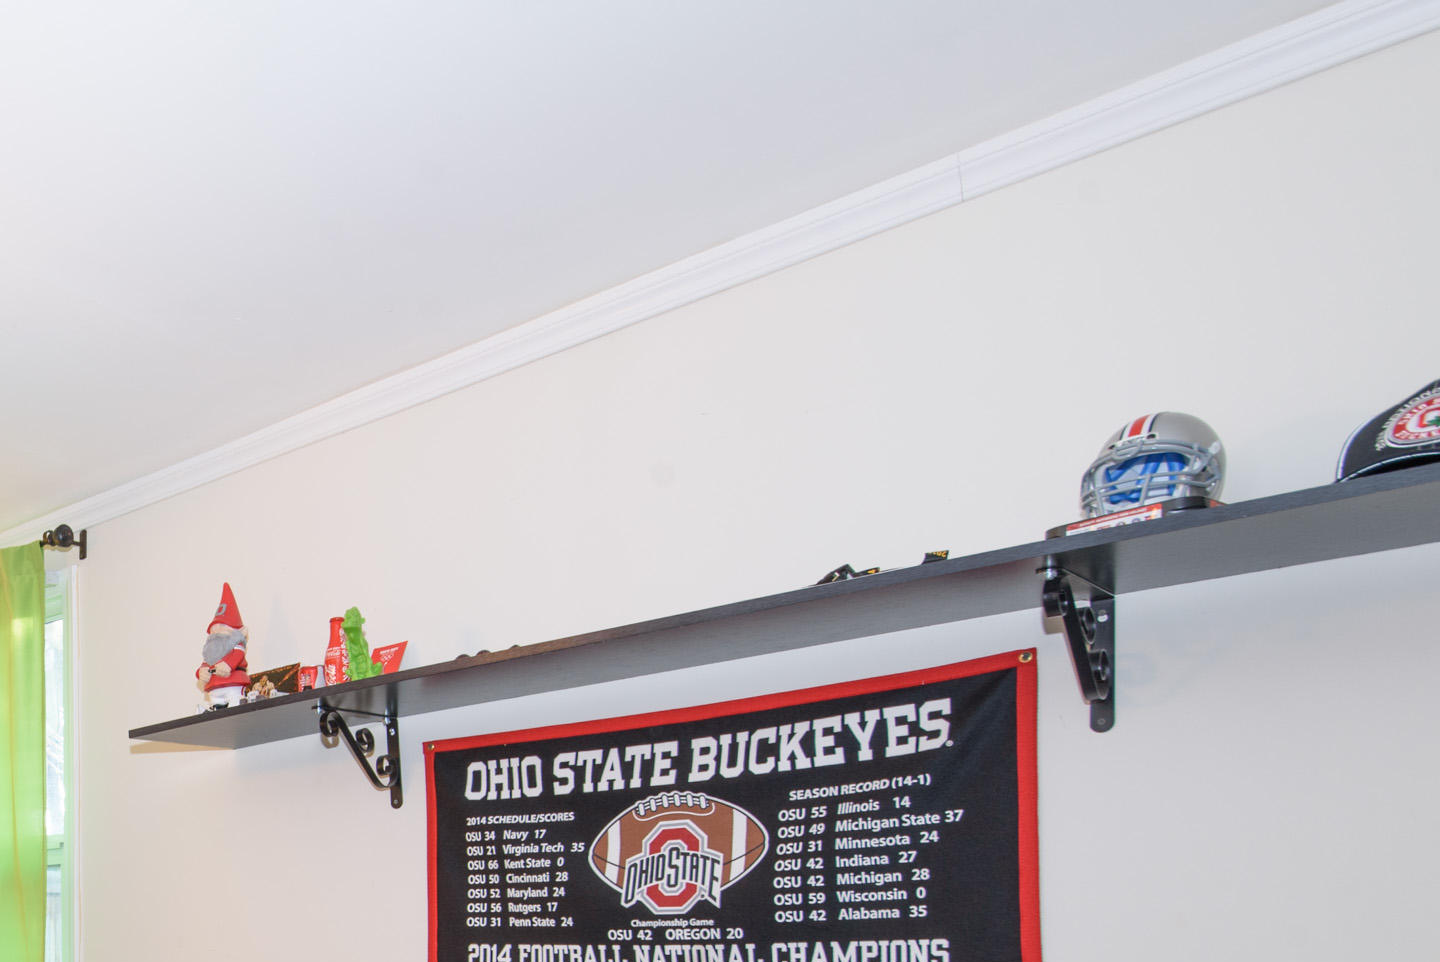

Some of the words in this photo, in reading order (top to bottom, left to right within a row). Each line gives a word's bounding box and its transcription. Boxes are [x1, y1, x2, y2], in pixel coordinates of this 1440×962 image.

[464, 756, 543, 800] OHIO
[552, 741, 679, 795] STATE
[789, 786, 839, 801] SEASON
[840, 779, 890, 795] RECORD
[891, 773, 932, 789] (14-1)
[778, 808, 806, 821] OSU
[811, 806, 827, 818] 55
[837, 800, 880, 814] Illinois
[893, 796, 911, 808] 14
[466, 817, 486, 826] 2014
[488, 812, 575, 824] SCHEDULE/SCORES
[778, 825, 804, 838] OSU
[809, 823, 825, 835] 49
[835, 818, 899, 832] Michigan
[901, 813, 940, 826] State
[945, 810, 964, 822] 37
[465, 832, 481, 842] OSU
[484, 831, 495, 841] 34
[503, 830, 529, 841] Navy
[534, 829, 546, 838] 17
[776, 843, 803, 855] OSU
[808, 840, 823, 852] 31
[835, 835, 910, 849] Minnesota
[920, 830, 939, 843] 24
[467, 846, 484, 856] OSU
[487, 846, 496, 855] 21
[503, 843, 539, 856] Virginia
[540, 842, 564, 853] Tech
[570, 843, 585, 852] 35
[467, 861, 485, 870] OSU
[488, 860, 499, 869] 66
[504, 860, 525, 869] Kent
[526, 858, 551, 868] State
[557, 857, 564, 867] 0
[774, 859, 801, 871] OSU
[806, 858, 824, 869] 42
[835, 855, 889, 867] Indiana
[899, 851, 917, 863] 27
[468, 875, 486, 884] OSU
[489, 875, 499, 884] 50
[506, 872, 550, 883] Cincinnati
[555, 872, 568, 882] 28
[773, 876, 801, 889] OSU
[807, 876, 824, 887] 42
[836, 871, 902, 885] Michigan
[911, 868, 930, 880] 28
[468, 889, 487, 898] OSU
[490, 889, 500, 898] 52
[507, 887, 548, 900] Maryland
[553, 887, 565, 897] 24
[774, 893, 802, 906] OSU
[808, 893, 826, 904] 59
[836, 888, 907, 903] Wisconsin
[916, 887, 926, 899] 0
[467, 903, 487, 913] OSU
[491, 903, 502, 912] 56
[508, 903, 541, 914] Rutgers
[547, 902, 558, 912] 17
[775, 911, 803, 922] OSU
[809, 910, 827, 921] 42
[838, 907, 900, 920] Alabama
[909, 905, 927, 917] 35
[466, 917, 487, 927] OSU
[490, 917, 501, 927] 31
[509, 917, 531, 927] Penn
[532, 917, 555, 927] State
[561, 917, 574, 927] 24
[631, 919, 688, 928] Championship
[689, 918, 714, 926] Game
[608, 930, 632, 940] OSU
[637, 930, 653, 940] 42
[665, 928, 721, 940] OREGON
[726, 928, 744, 939] 20
